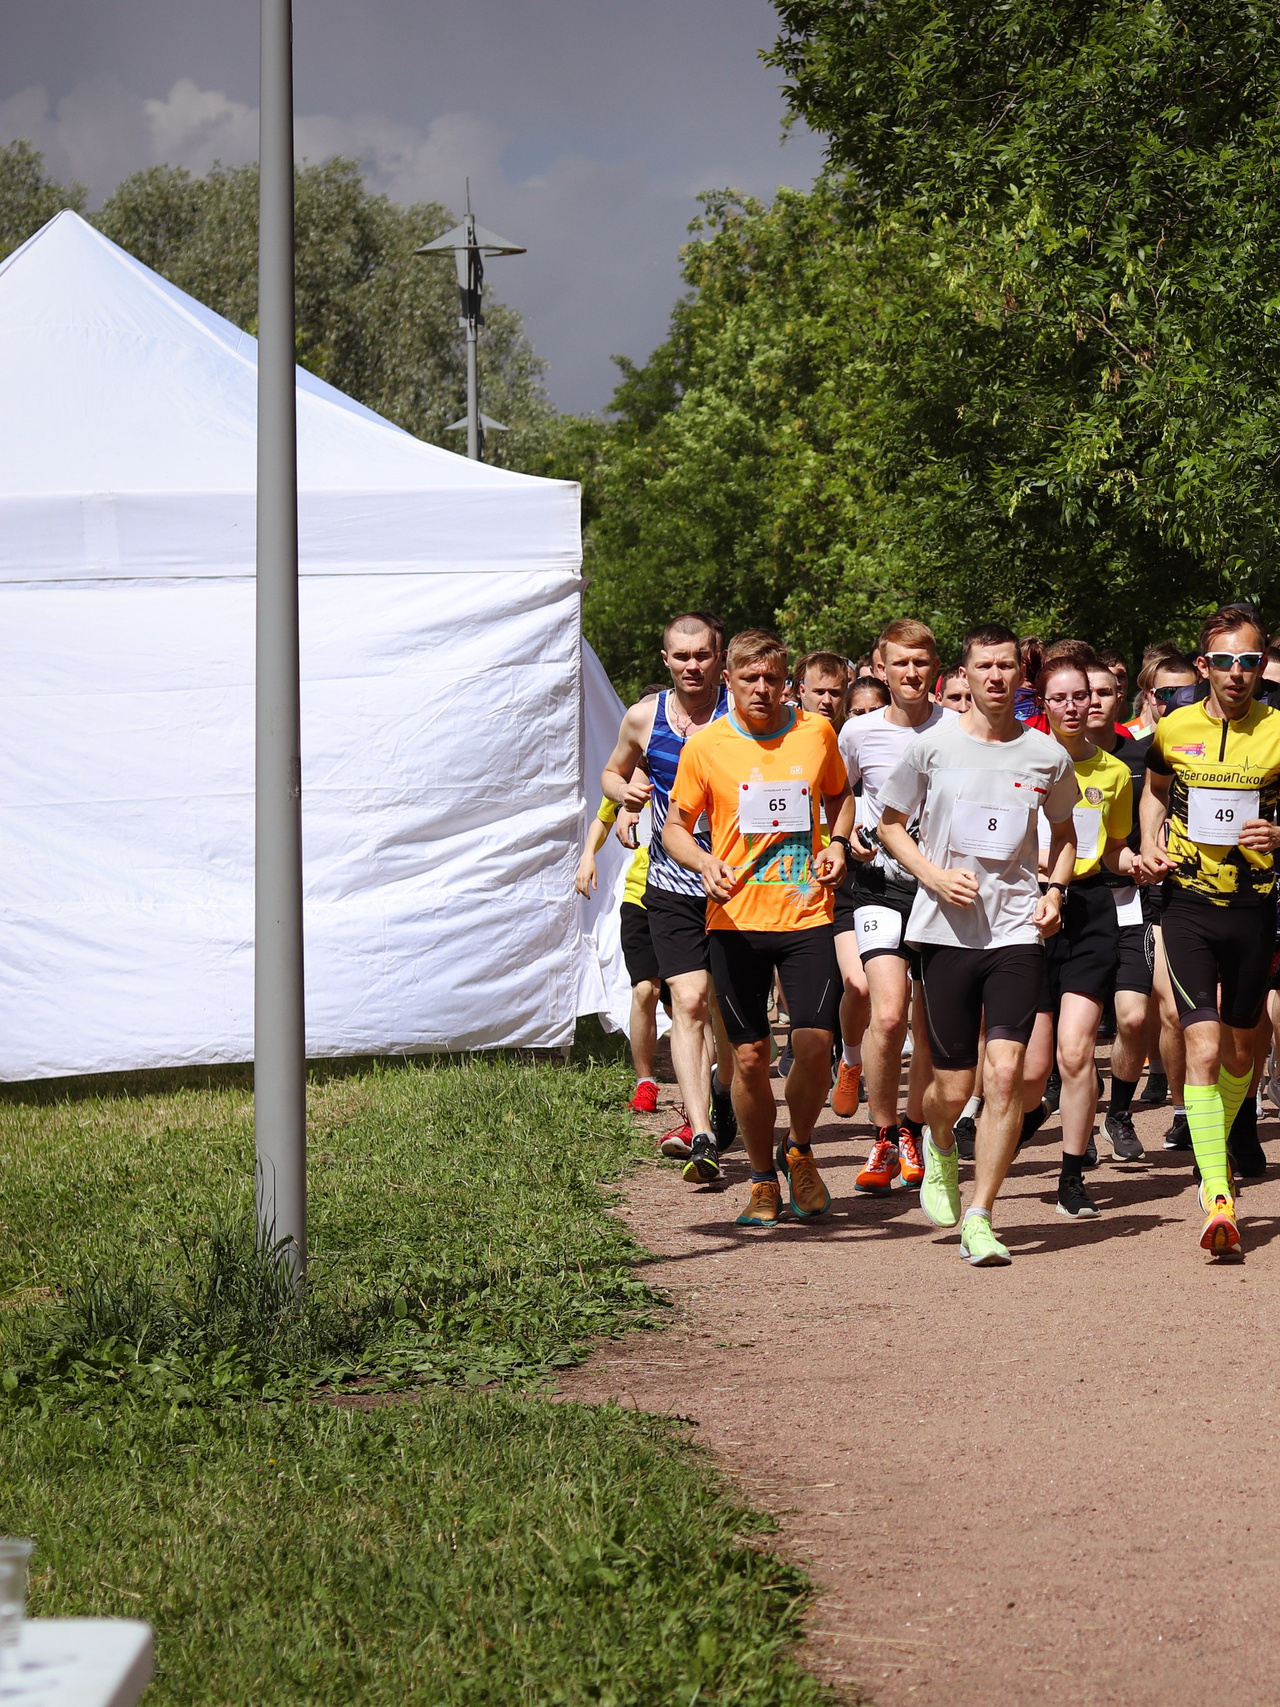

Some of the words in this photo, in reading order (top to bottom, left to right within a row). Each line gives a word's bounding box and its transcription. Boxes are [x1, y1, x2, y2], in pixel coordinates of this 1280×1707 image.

[769, 799, 786, 811] 65
[1214, 809, 1234, 822] 49
[988, 818, 997, 831] 8
[863, 920, 878, 932] 63
